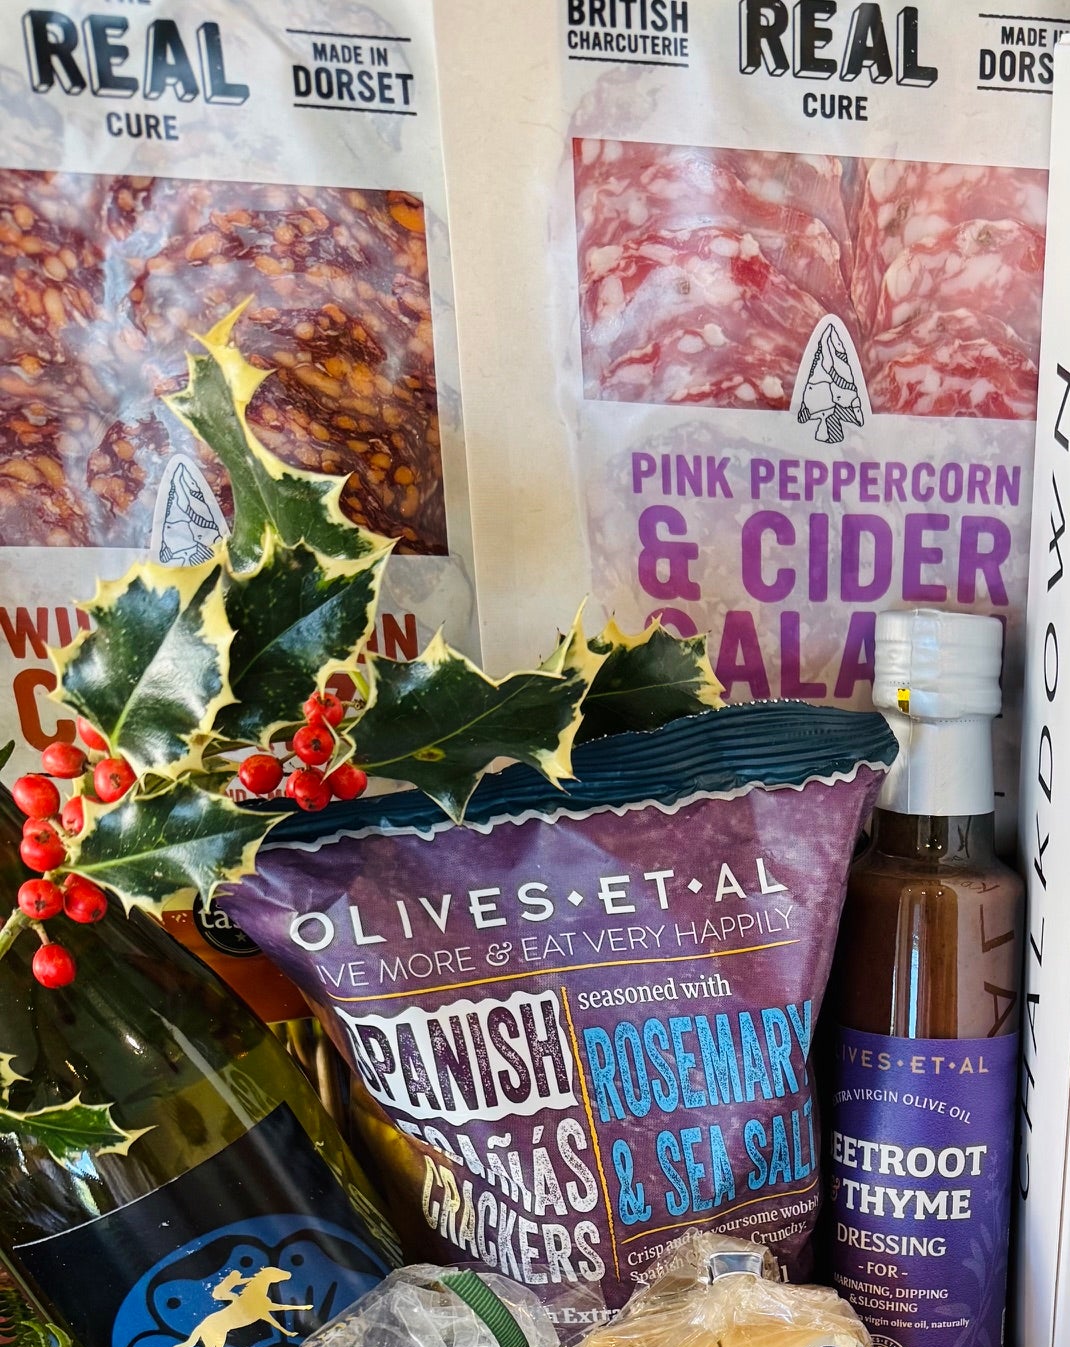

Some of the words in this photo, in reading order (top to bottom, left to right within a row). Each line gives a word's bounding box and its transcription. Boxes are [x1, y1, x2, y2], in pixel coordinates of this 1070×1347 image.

[567, 0, 689, 33] BRITISH
[313, 42, 364, 64] MADE
[370, 46, 389, 66] IN
[567, 29, 689, 57] CHARCUTERIE
[739, 0, 938, 88] REAL
[1000, 26, 1049, 48] MADE
[22, 8, 249, 105] REAL
[292, 65, 415, 106] DORSET
[802, 91, 868, 122] CURE
[106, 112, 179, 141] CURE
[631, 451, 732, 500] PINK
[750, 458, 1021, 507] PEPPERCORN
[637, 504, 701, 602] &
[741, 509, 1011, 607] CIDER
[379, 946, 476, 985] MORE
[486, 941, 512, 967] &
[521, 932, 576, 962] EAT
[582, 925, 665, 956] VERY
[678, 904, 795, 947] HAPPILY
[578, 980, 677, 1010] seasoned
[680, 973, 733, 999] with
[581, 998, 813, 1123] ROSEMARY
[854, 1089, 898, 1104] VIRGIN
[903, 1094, 946, 1114] OLIVE
[949, 1106, 971, 1125] OIL
[613, 1138, 652, 1225] &
[657, 1125, 737, 1217] SEA
[747, 1105, 819, 1193] SALT
[831, 1130, 987, 1178] EETROOT
[843, 1178, 971, 1220] THYME
[423, 1154, 605, 1285] CRACKERS
[627, 1243, 665, 1266] Crisp
[837, 1222, 946, 1257] DRESSING
[867, 1262, 898, 1279] FOR
[859, 1297, 918, 1313] SLOSHING
[896, 1288, 948, 1299] DIPPING
[866, 1315, 888, 1327] virgin
[891, 1319, 912, 1329] olive
[914, 1320, 929, 1330] oil,
[931, 1318, 969, 1330] naturally
